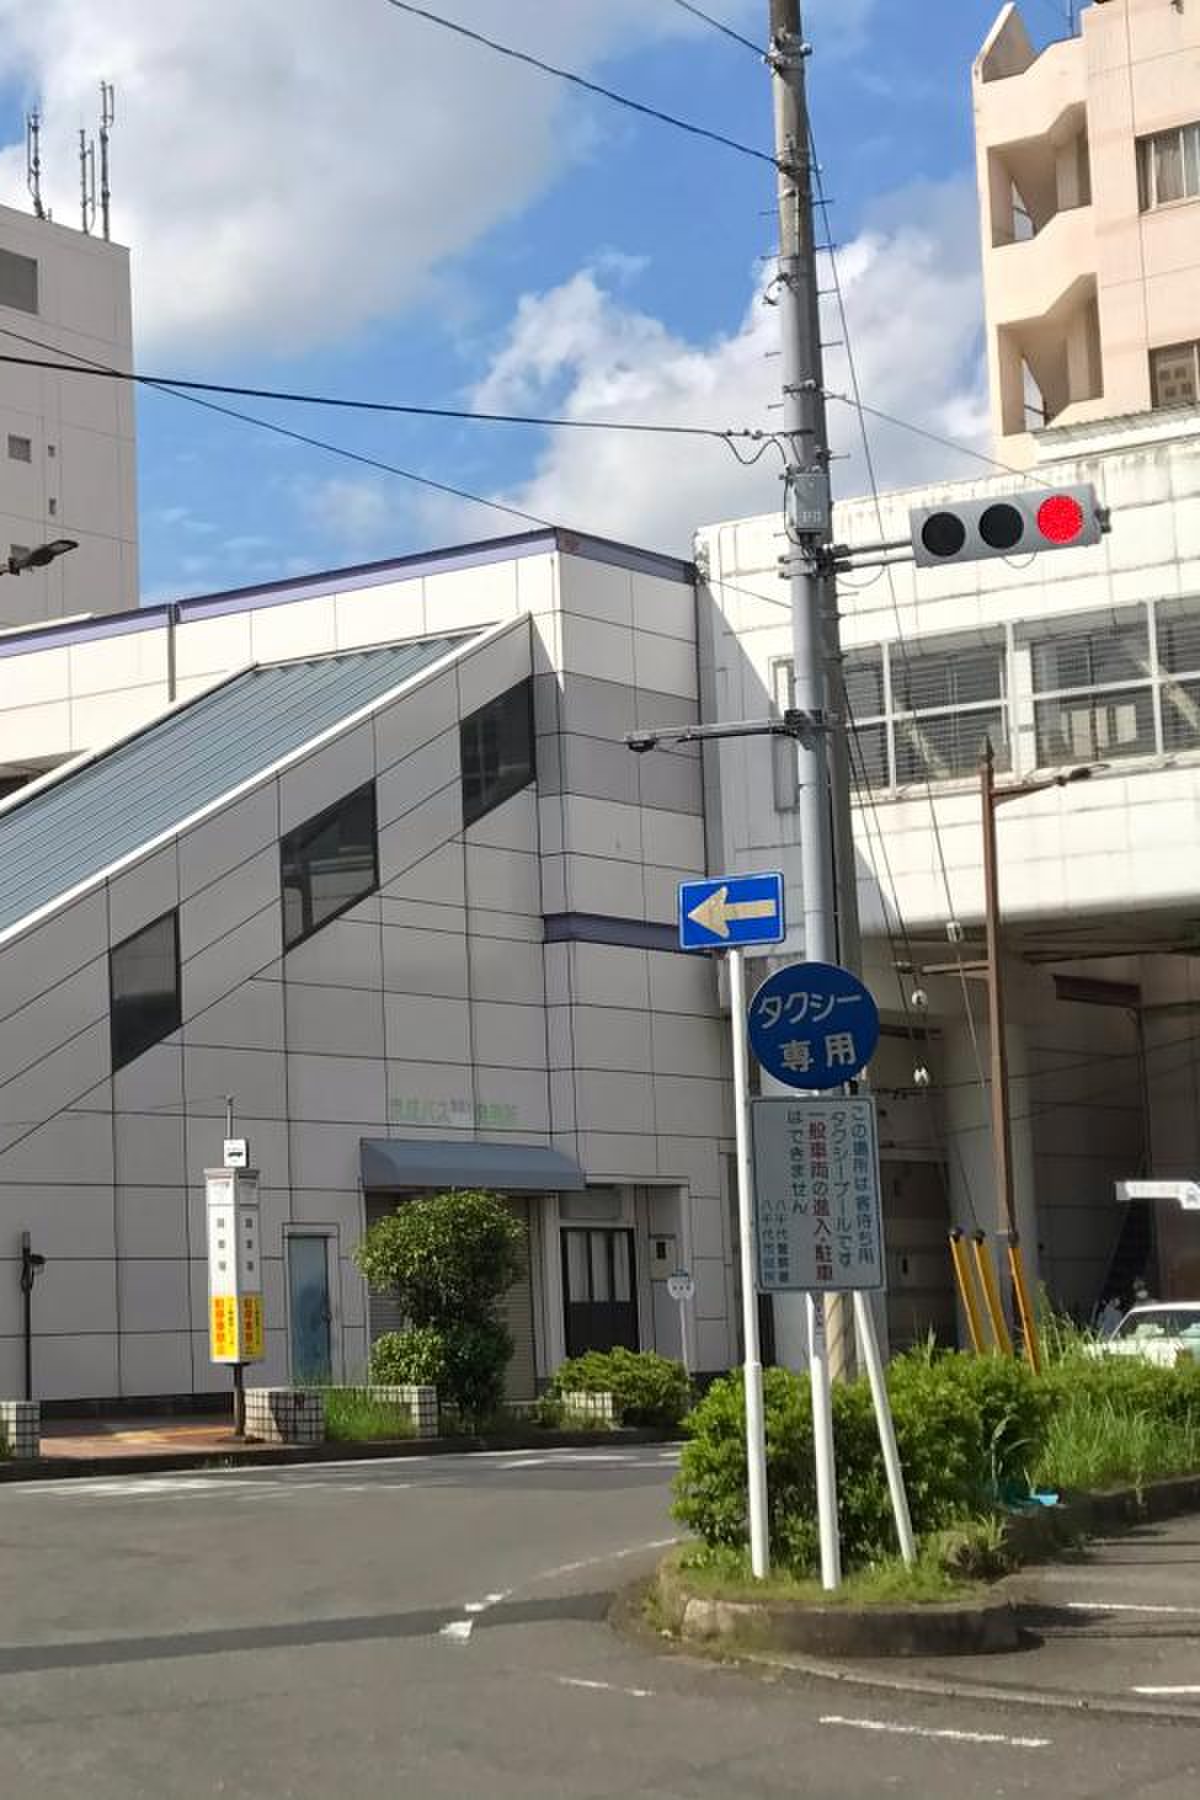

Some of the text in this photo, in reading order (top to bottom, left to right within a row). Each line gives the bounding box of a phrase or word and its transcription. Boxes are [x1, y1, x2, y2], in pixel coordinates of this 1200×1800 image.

[759, 992, 861, 1029] タクシー
[779, 1032, 857, 1072] 専用
[787, 1109, 808, 1215] はできません
